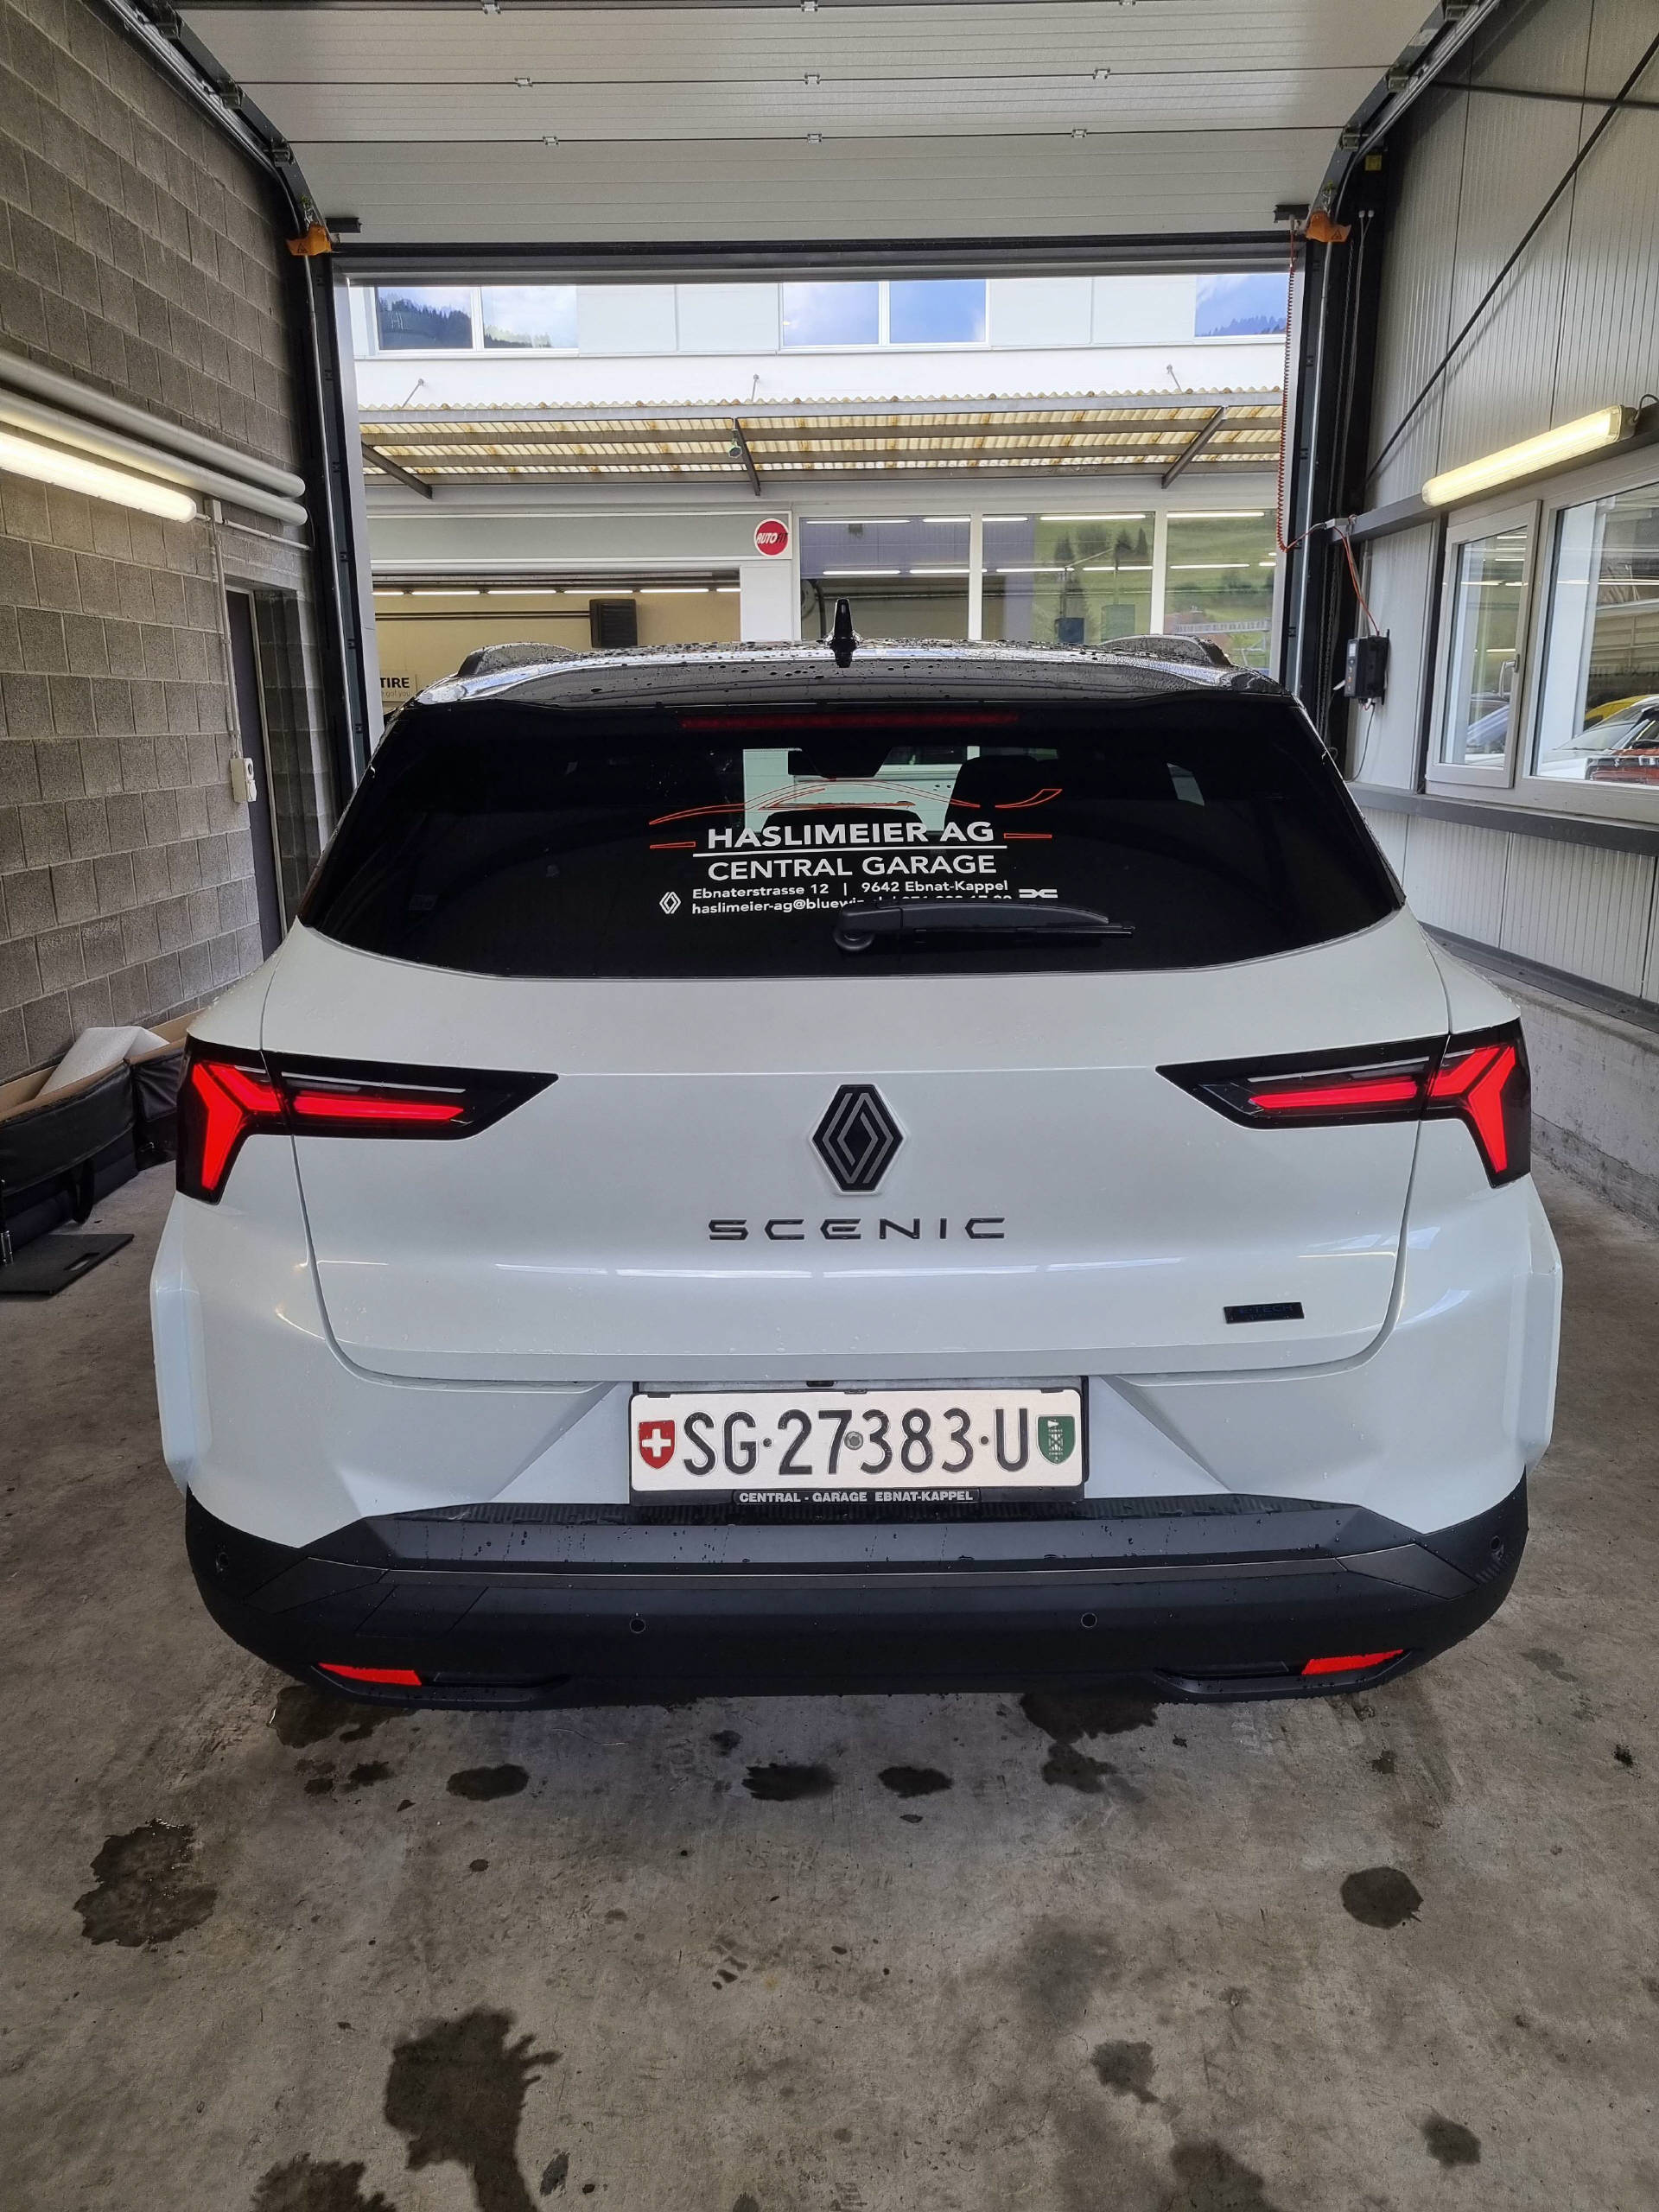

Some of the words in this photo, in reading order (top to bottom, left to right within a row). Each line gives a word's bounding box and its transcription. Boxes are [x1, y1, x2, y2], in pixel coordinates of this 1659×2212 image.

[380, 677, 410, 689] TIRE
[708, 823, 928, 849] HASLIMEIER
[939, 822, 995, 842] AG
[708, 858, 853, 881] CENTRAL
[861, 855, 997, 876] GARAGE
[692, 884, 805, 899] Ebnaterstrasse
[810, 883, 830, 894] 12
[861, 881, 900, 893] 9642
[905, 880, 1008, 894] Ebnat-Kappel
[708, 1217, 1006, 1241] SCENIC
[740, 1492, 801, 1503] CENTRAL
[812, 1491, 868, 1503] GARAGE
[874, 1491, 974, 1502] EBNAT-KAPPEL
